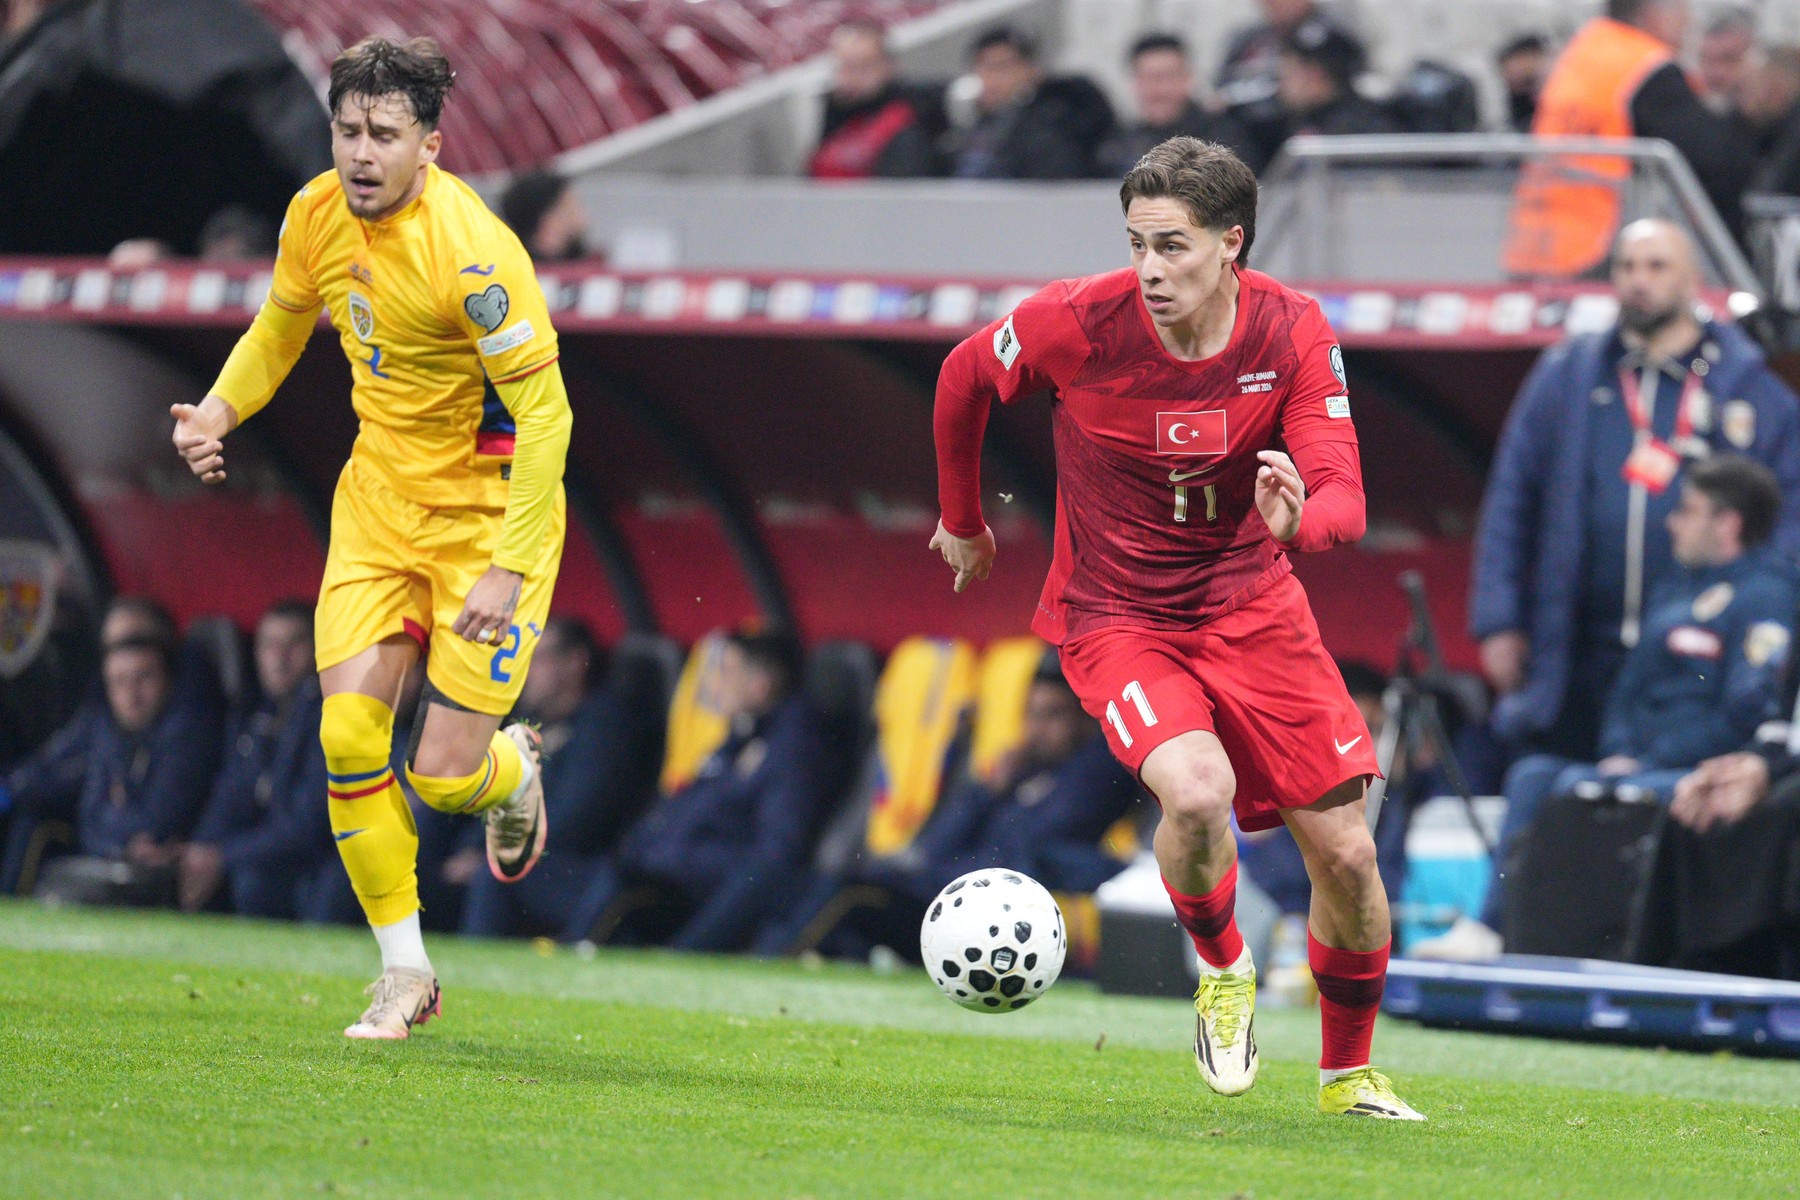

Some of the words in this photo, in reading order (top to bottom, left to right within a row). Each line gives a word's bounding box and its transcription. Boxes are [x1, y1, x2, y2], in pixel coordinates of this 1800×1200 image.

[1241, 385, 1248, 394] 26
[1248, 384, 1260, 393] MART
[1261, 383, 1272, 392] 2026
[1170, 484, 1217, 522] 11
[490, 623, 521, 684] 2
[1105, 680, 1159, 749] 11
